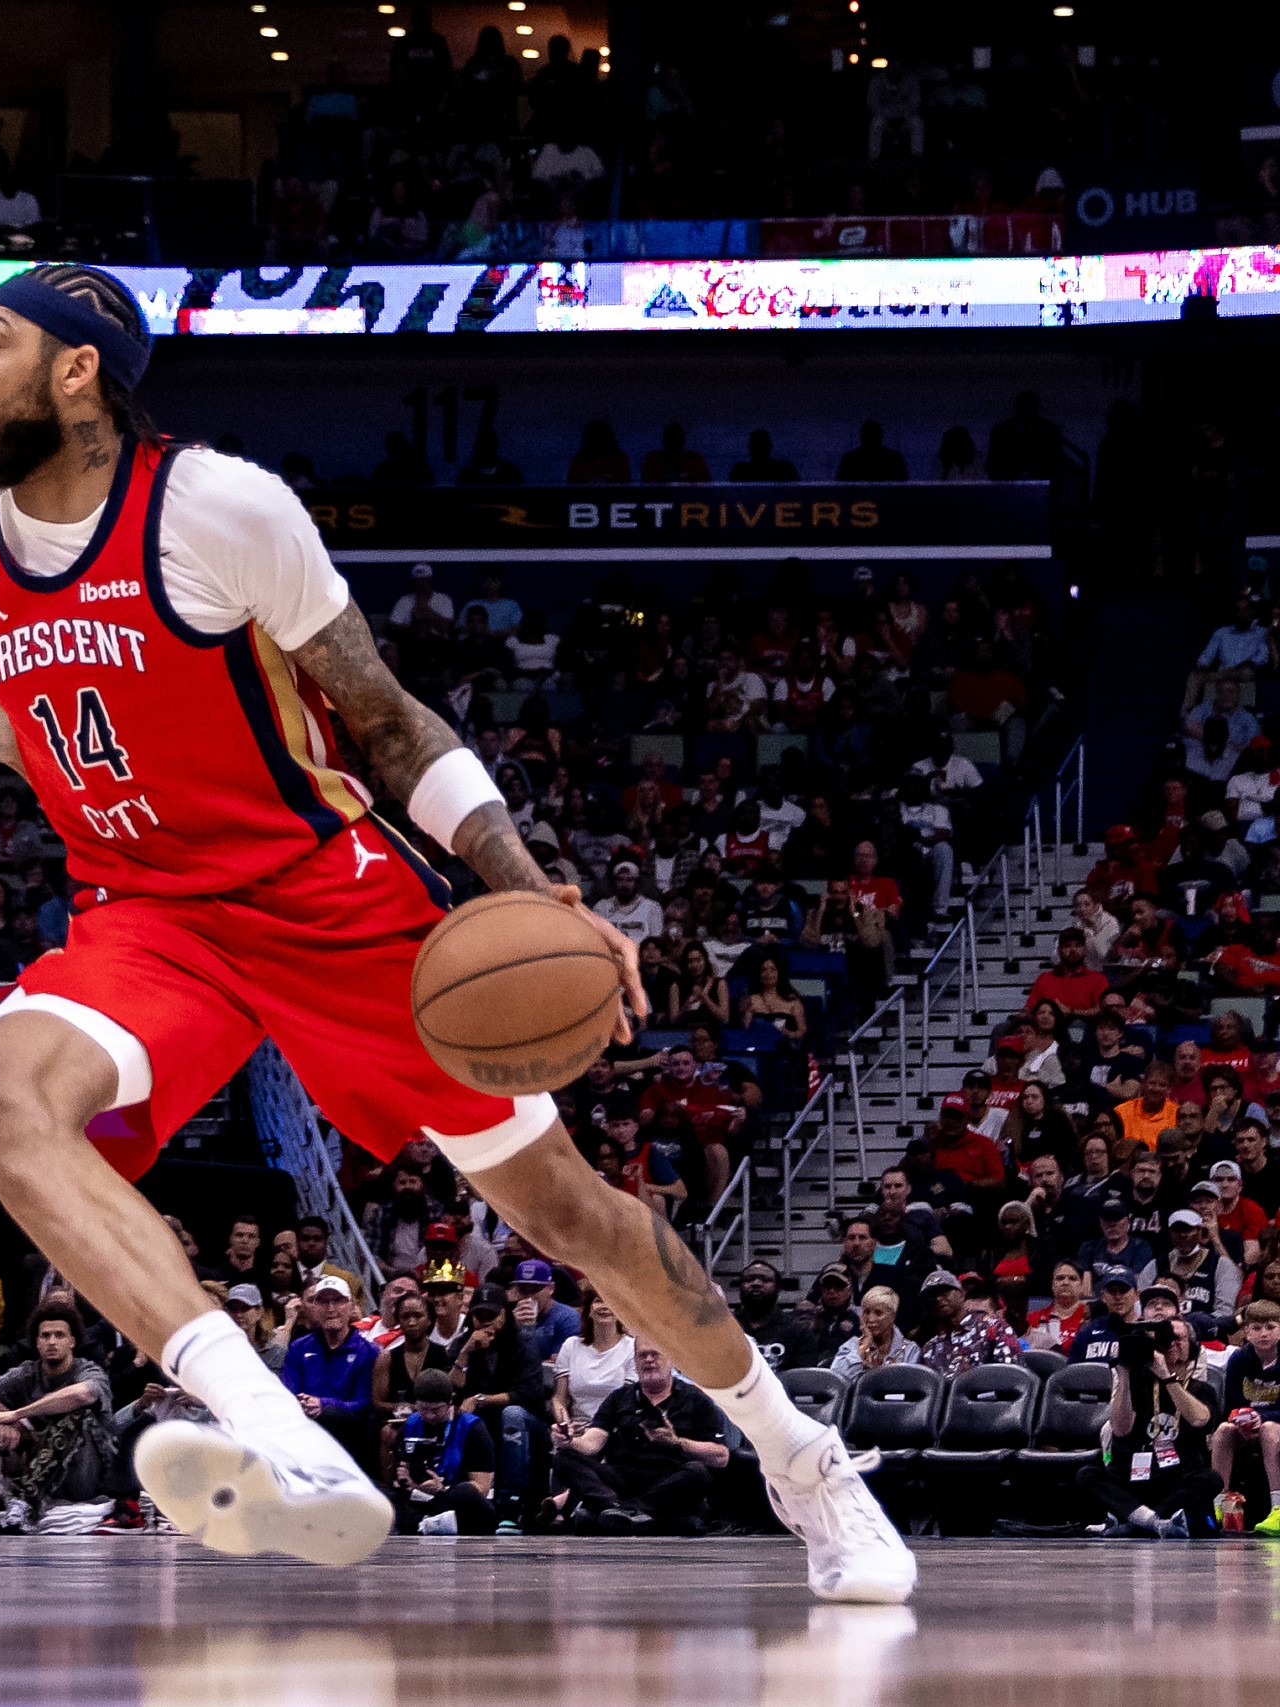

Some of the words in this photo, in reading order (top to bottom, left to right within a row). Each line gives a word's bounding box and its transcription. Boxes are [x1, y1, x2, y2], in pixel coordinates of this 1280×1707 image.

[1125, 188, 1198, 218] HUB
[403, 386, 498, 463] 117
[569, 502, 881, 529] BETRIVERS
[79, 580, 141, 603] ibotta
[28, 686, 134, 791] 14
[81, 795, 160, 840] CITY
